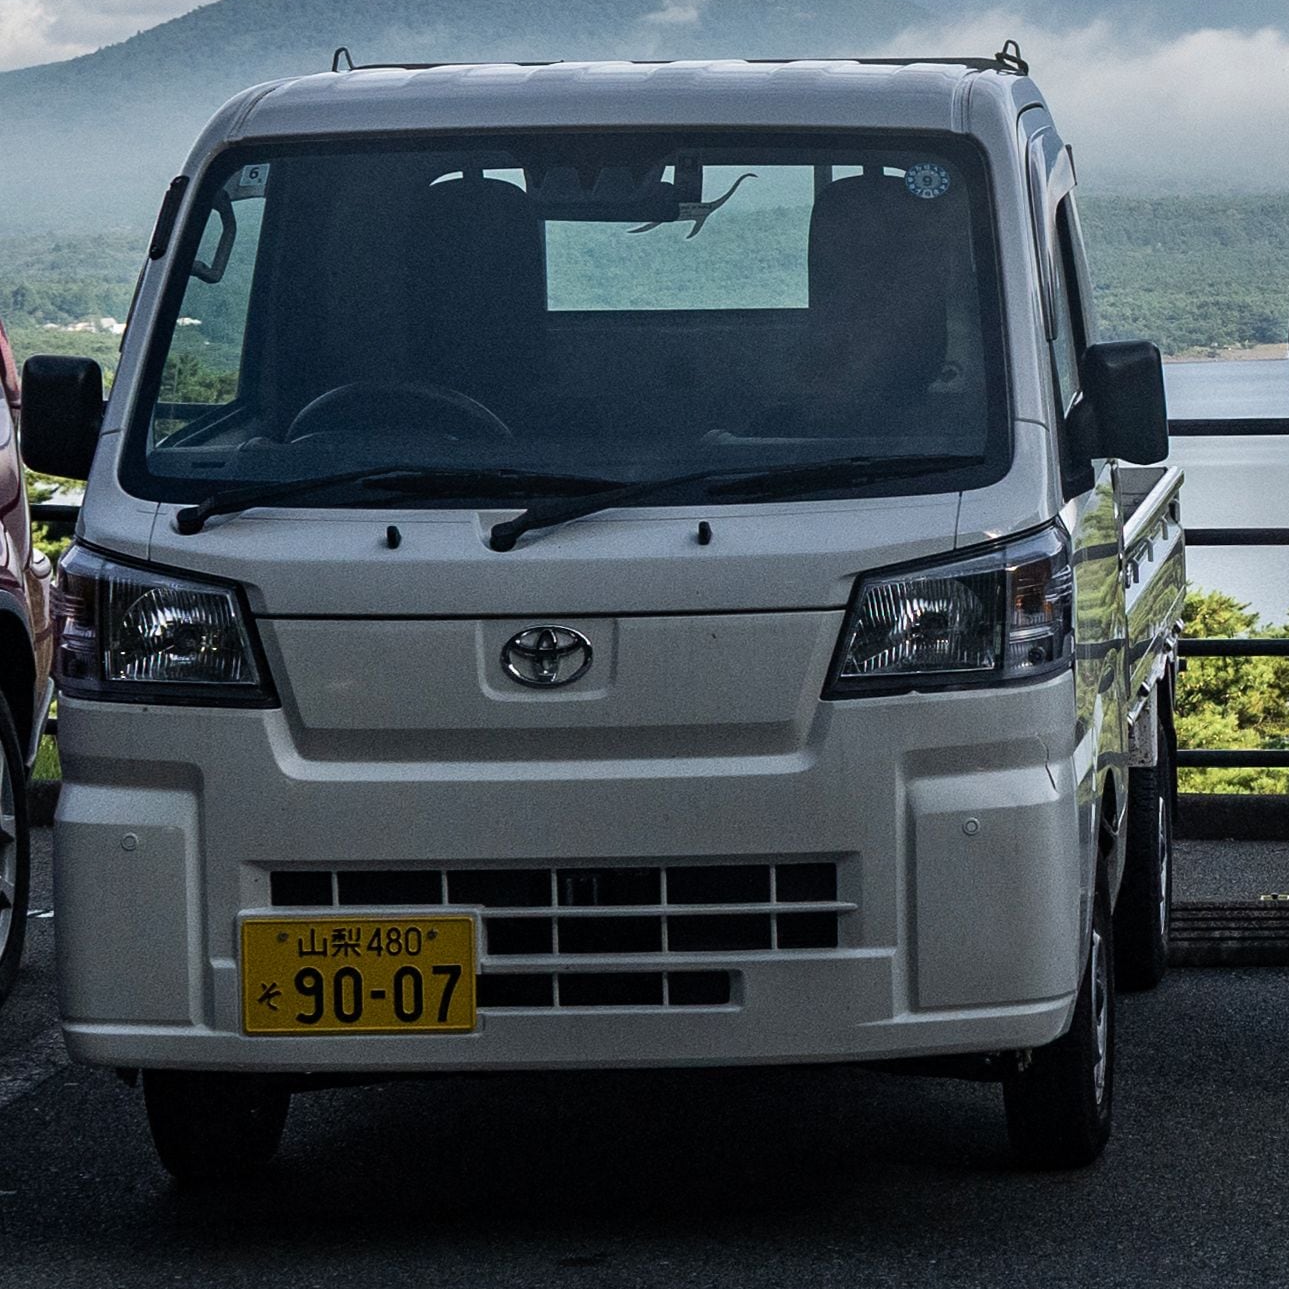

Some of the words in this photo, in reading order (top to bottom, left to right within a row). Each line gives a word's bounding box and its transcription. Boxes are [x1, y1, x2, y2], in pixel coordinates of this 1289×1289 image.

[249, 167, 260, 180] 6
[298, 928, 361, 957] 山梨
[366, 927, 422, 957] 480
[257, 982, 282, 1010] そ
[294, 965, 462, 1024] 90-07
